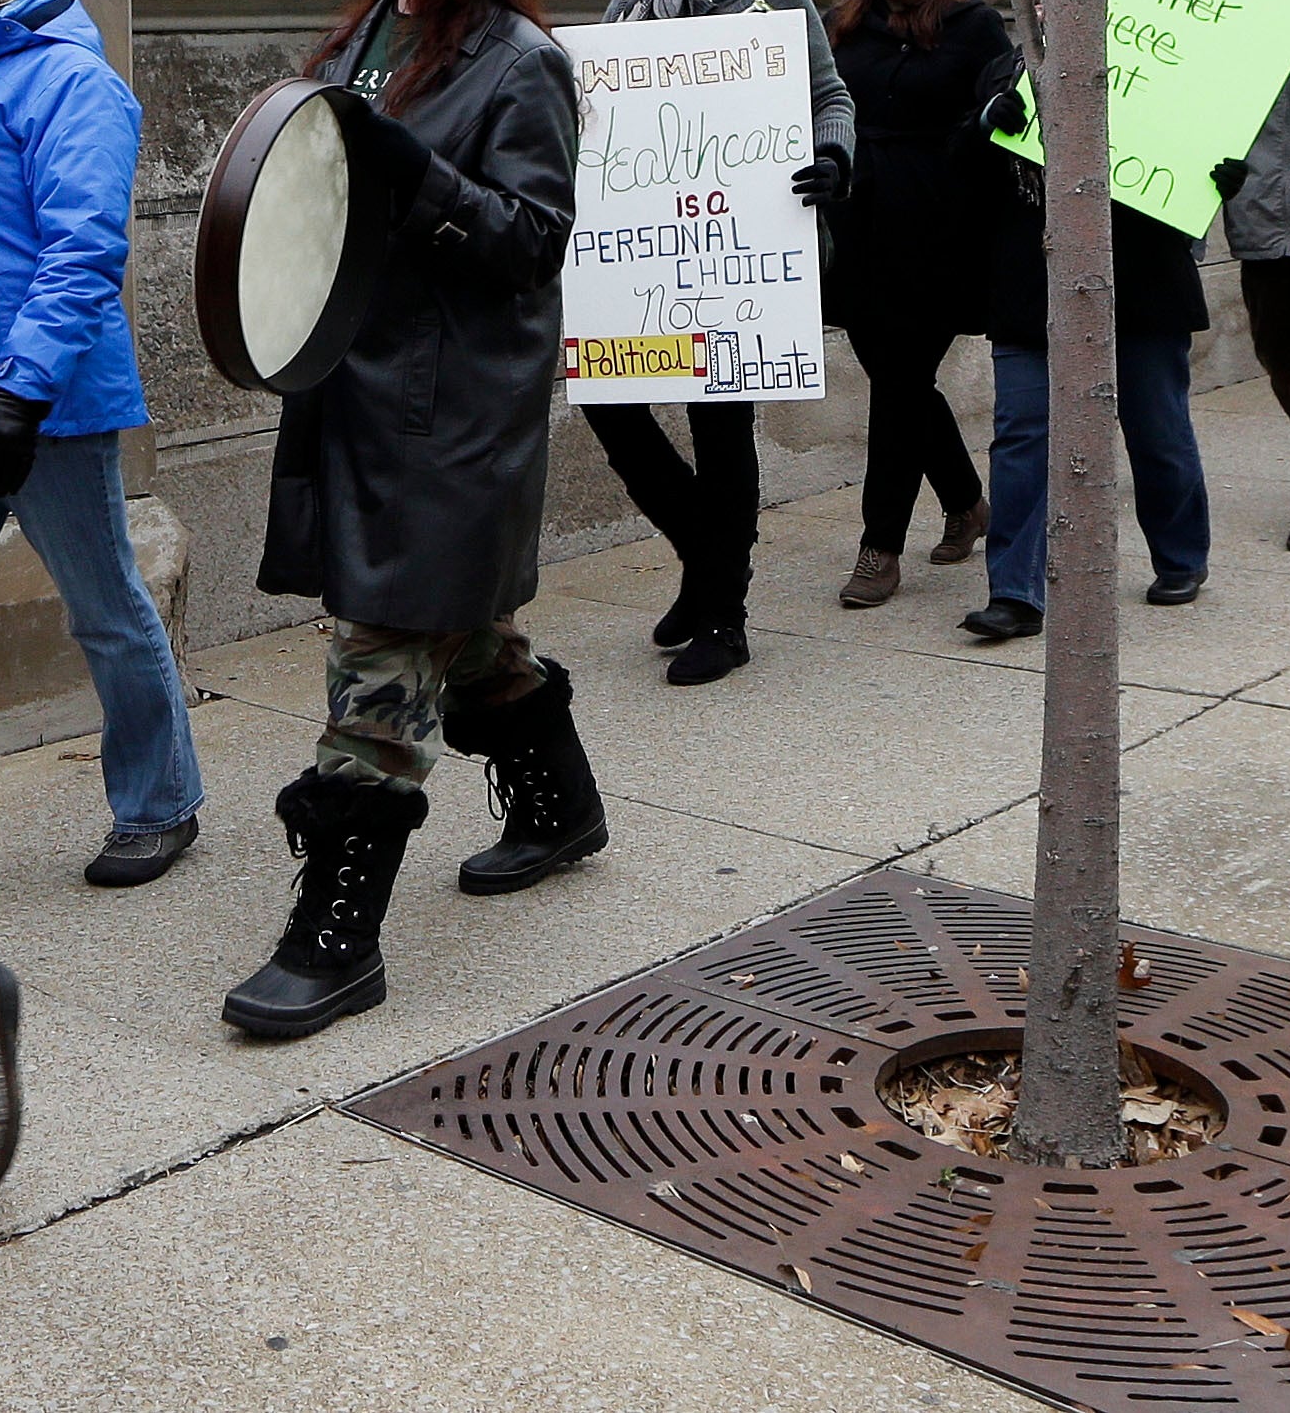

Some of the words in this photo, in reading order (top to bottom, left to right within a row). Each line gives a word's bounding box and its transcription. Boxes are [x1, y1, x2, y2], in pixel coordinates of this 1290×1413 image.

[581, 37, 786, 94] WOMEN'S
[576, 102, 807, 202] Healthcare
[676, 190, 701, 218] is
[706, 190, 730, 218] a
[572, 216, 751, 267] PERSONAL
[676, 249, 803, 290] CHOICE
[634, 284, 726, 336] Not
[736, 298, 764, 323] a
[582, 338, 691, 378] Political
[704, 330, 820, 395] Debate
